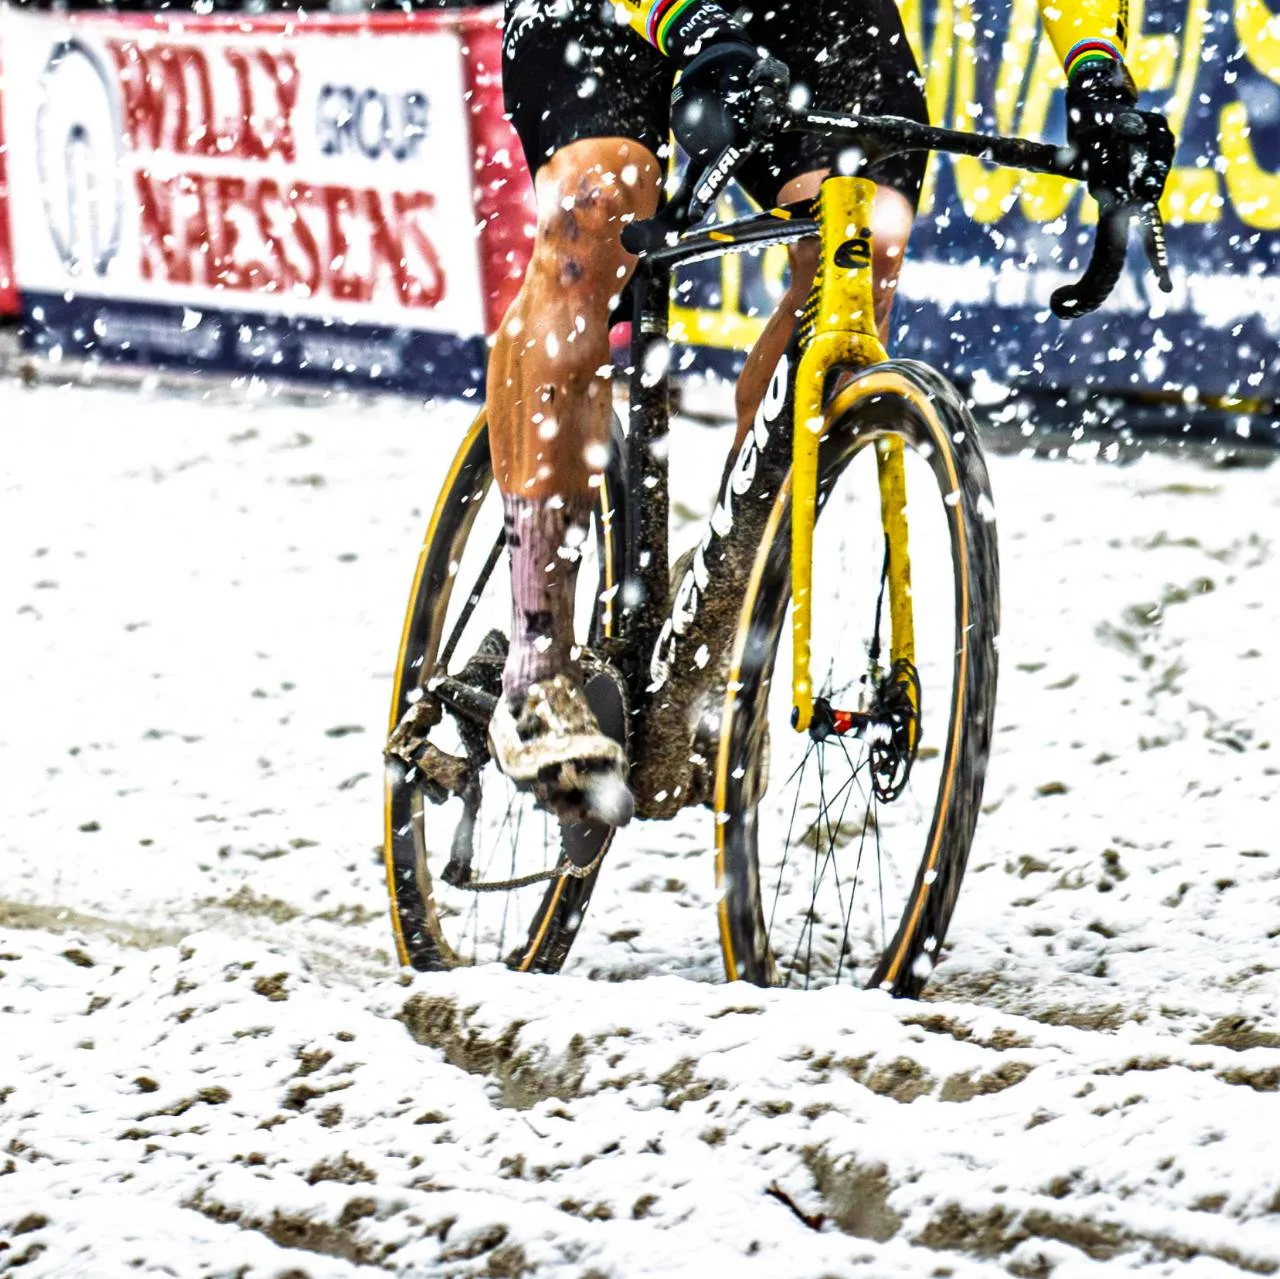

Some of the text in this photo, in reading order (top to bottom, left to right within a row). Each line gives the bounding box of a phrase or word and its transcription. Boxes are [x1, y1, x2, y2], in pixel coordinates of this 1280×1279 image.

[104, 36, 431, 164] WILLY GROUP
[131, 166, 448, 310] NAESSENS
